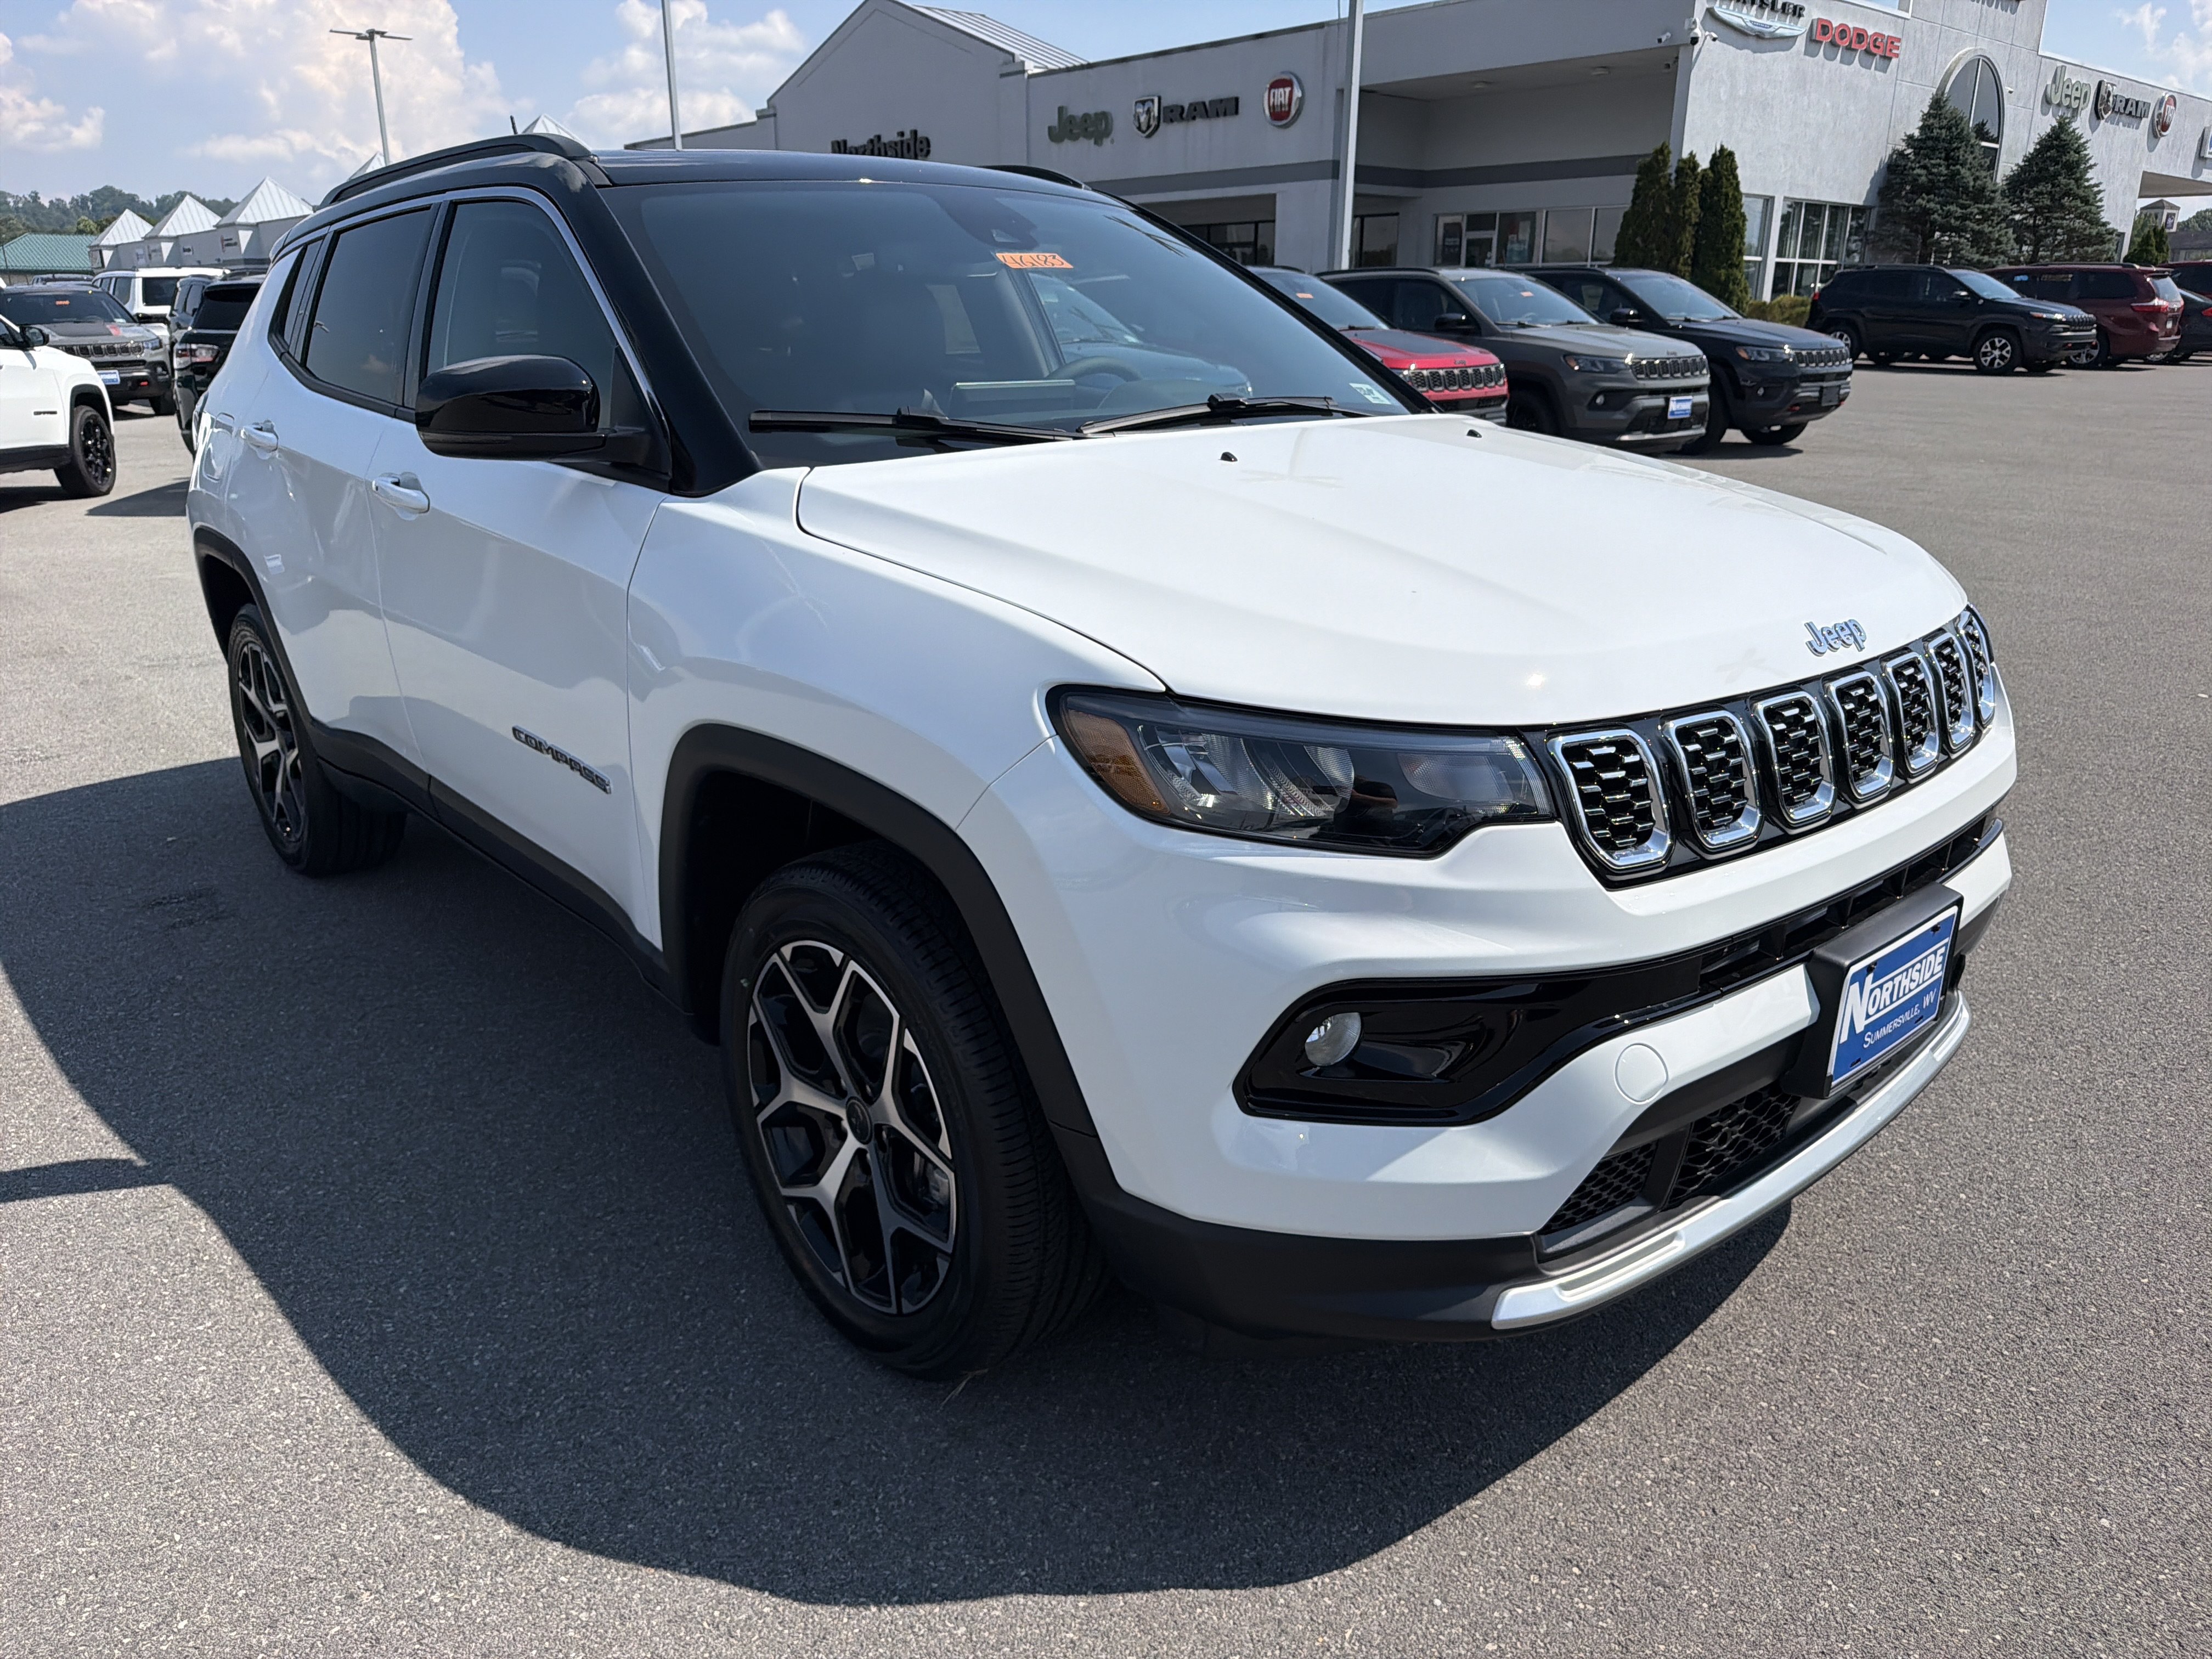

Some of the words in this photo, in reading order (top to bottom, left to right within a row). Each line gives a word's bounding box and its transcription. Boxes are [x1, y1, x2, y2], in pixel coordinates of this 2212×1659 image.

[1814, 18, 1901, 58] DODGE
[1269, 87, 1292, 112] FIAT
[2045, 65, 2091, 110] Jeep
[2113, 94, 2151, 118] RAM
[1047, 105, 1113, 146] Jeep
[1163, 96, 1239, 123] RAM
[1804, 619, 1867, 657] Jeep
[512, 725, 612, 794] COMPASS
[1839, 946, 1946, 1044] NORTHSIDE
[1863, 1003, 1920, 1048] SUMMERSVILLE,
[1922, 988, 1937, 1009] WV
